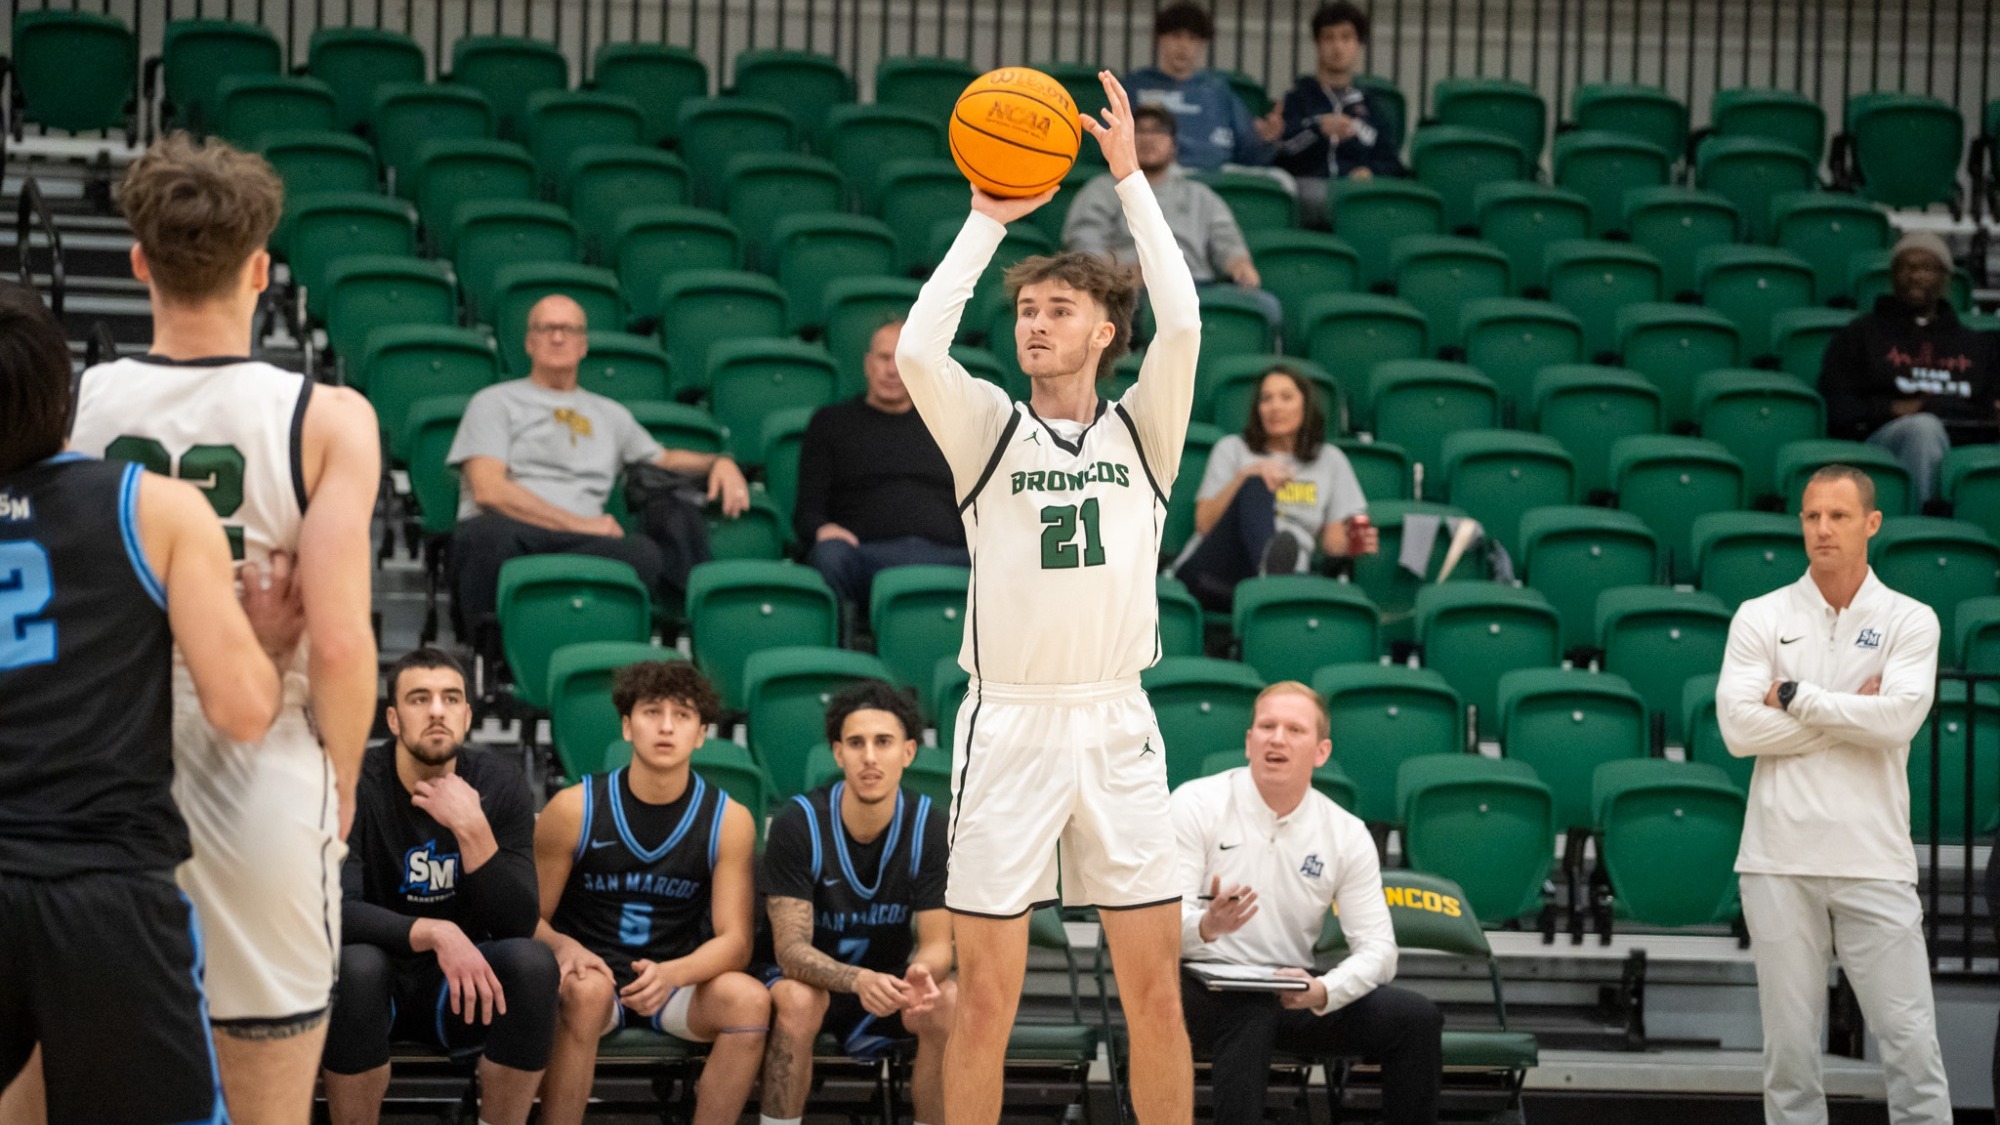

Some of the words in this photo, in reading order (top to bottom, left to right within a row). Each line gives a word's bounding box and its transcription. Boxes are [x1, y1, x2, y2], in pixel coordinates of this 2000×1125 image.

[986, 101, 1051, 137] NCAA
[1011, 461, 1130, 495] BRONCOS
[1041, 497, 1106, 569] 21
[406, 846, 457, 892] SM
[583, 872, 619, 892] SAN
[625, 871, 701, 900] MARCOS
[618, 902, 655, 947] 5
[815, 910, 845, 932] AN
[837, 937, 872, 967] 7
